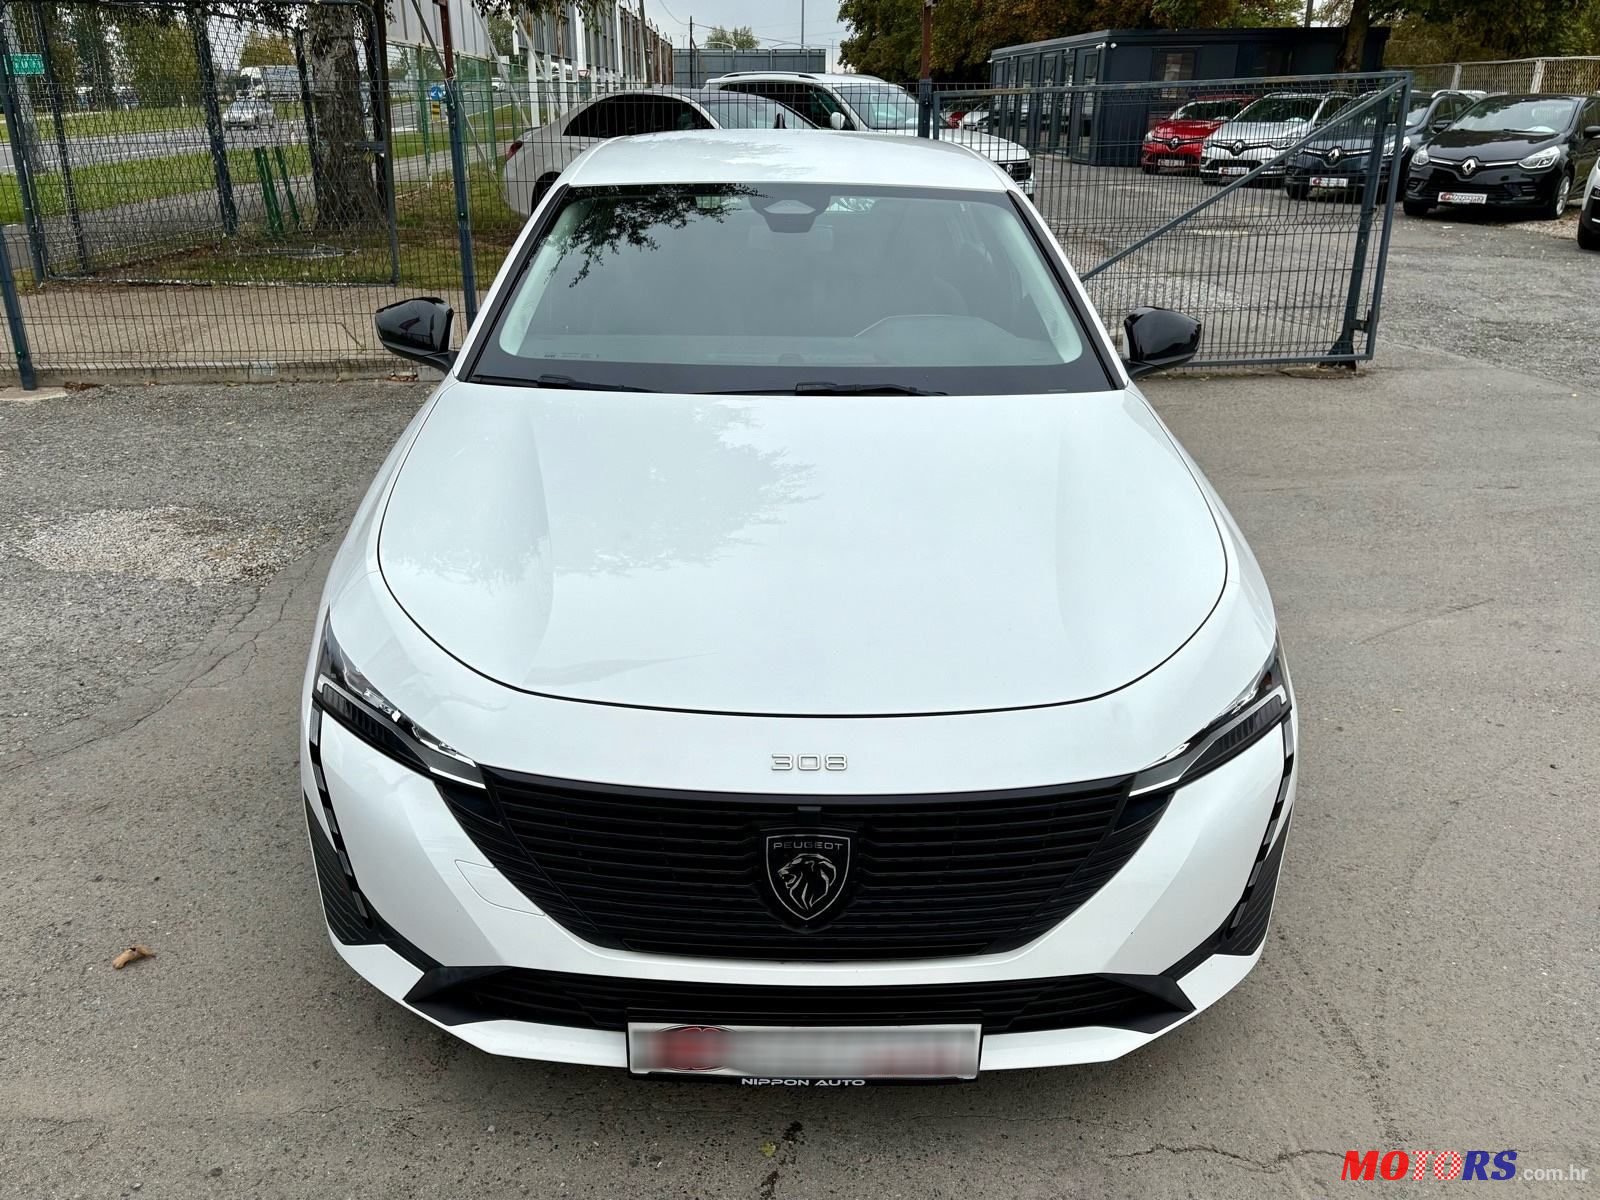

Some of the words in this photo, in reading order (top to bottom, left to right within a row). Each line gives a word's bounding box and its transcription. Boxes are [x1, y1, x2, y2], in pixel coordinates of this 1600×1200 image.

[770, 752, 848, 771] 308
[773, 841, 844, 850] PEUGEOT
[741, 1078, 810, 1086] NIPPON
